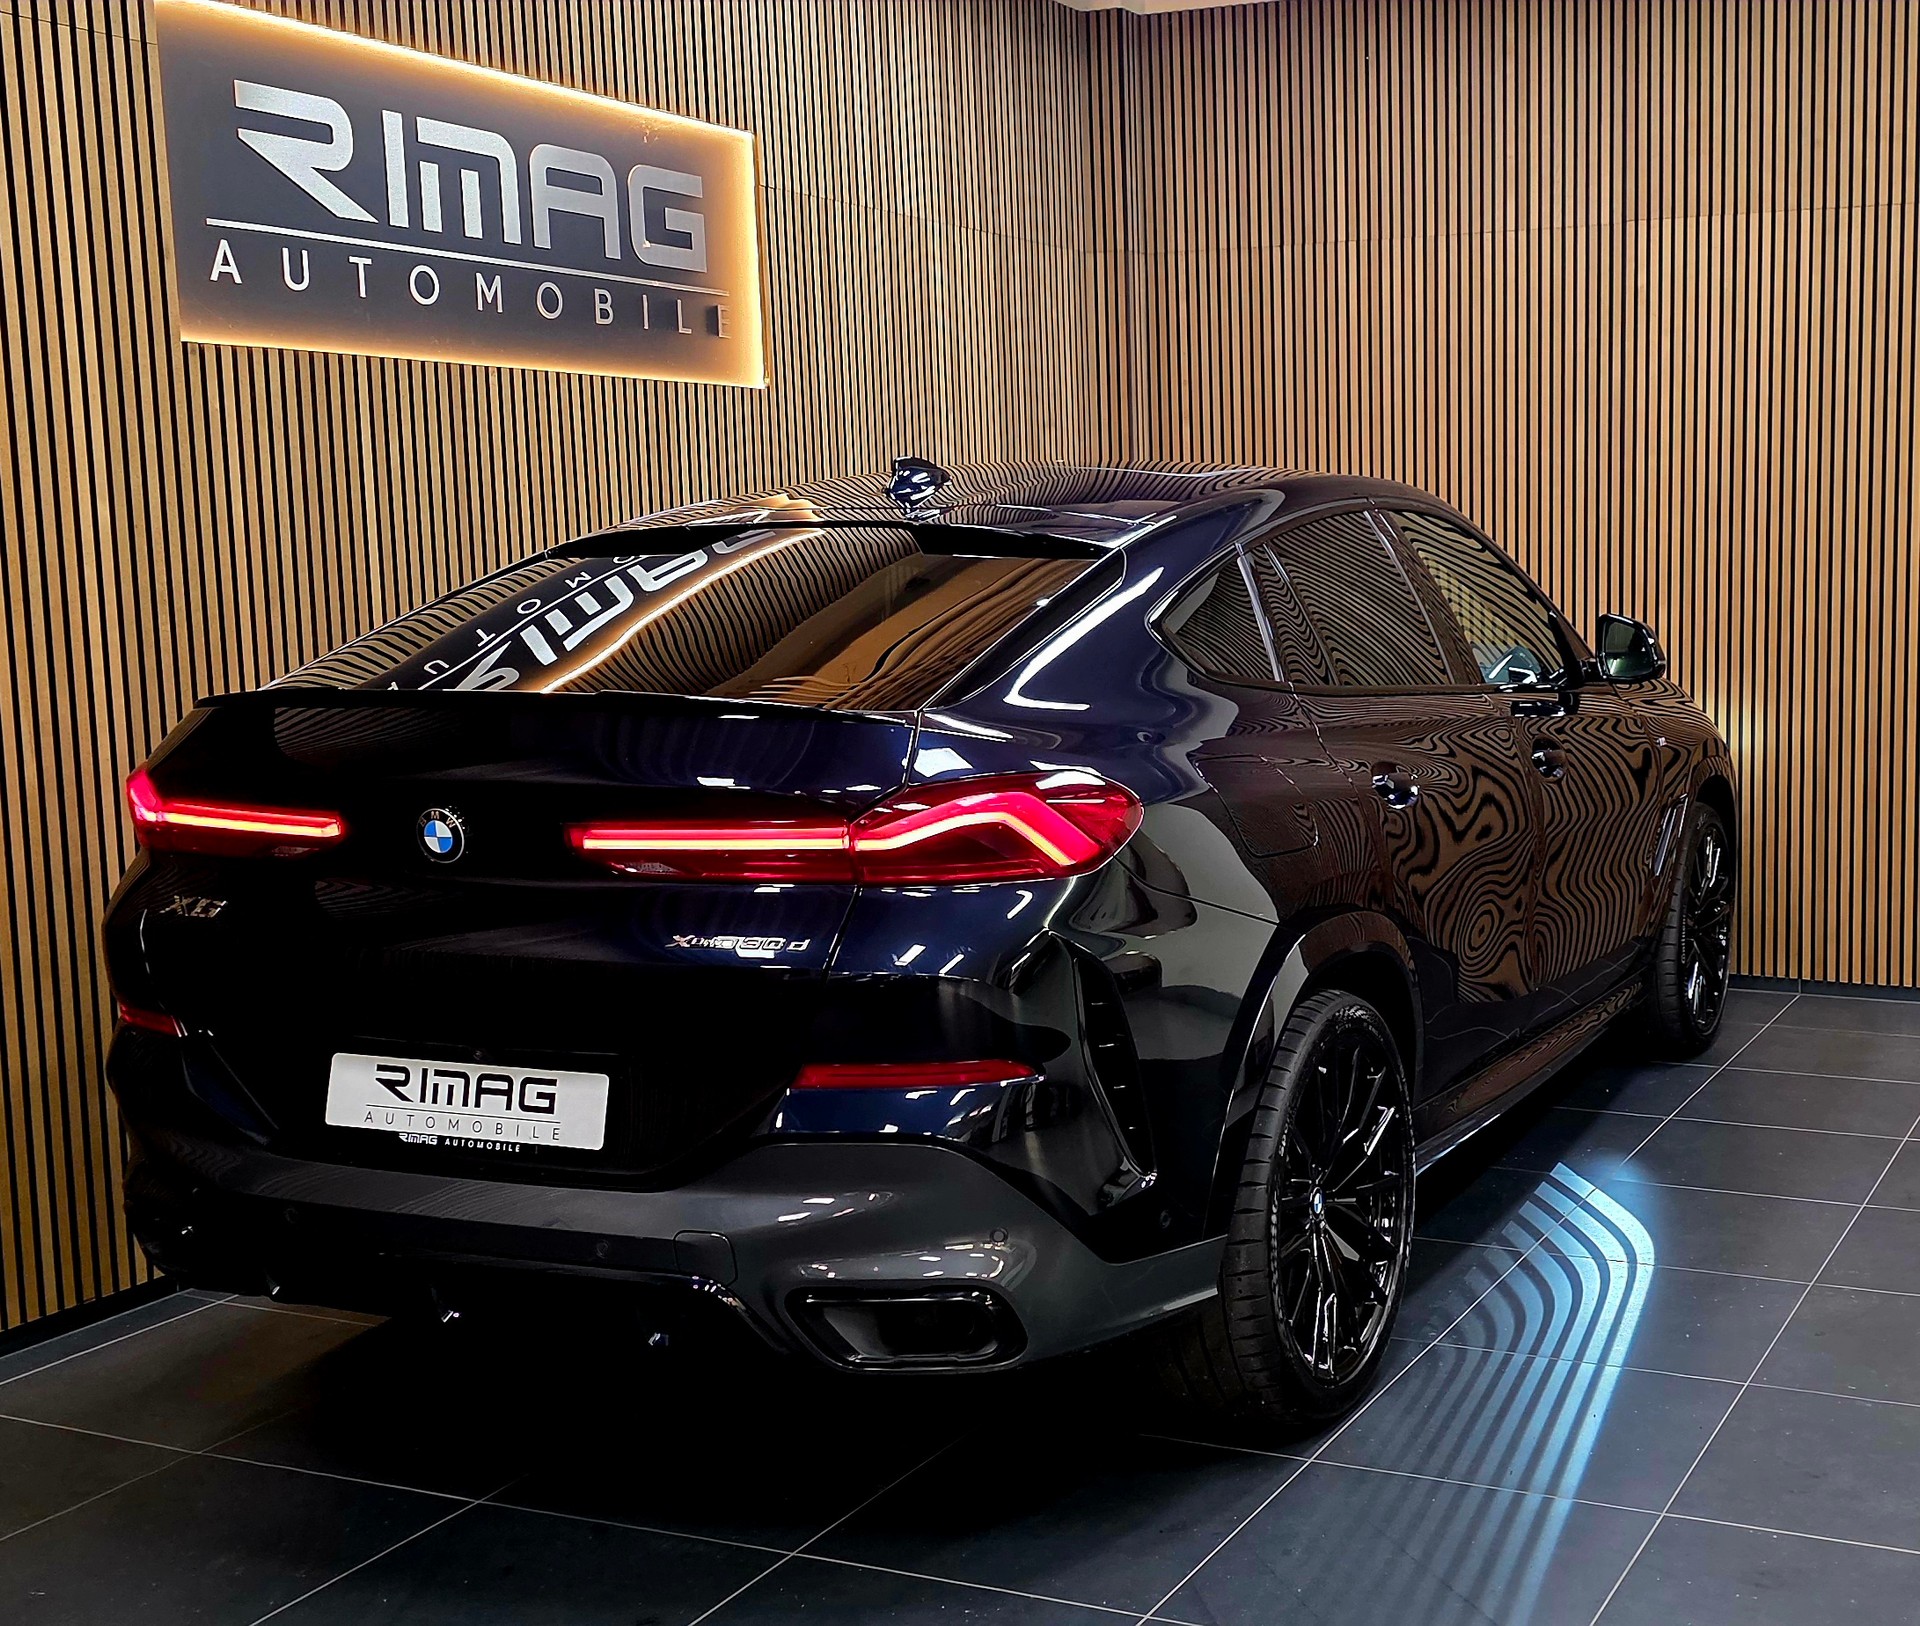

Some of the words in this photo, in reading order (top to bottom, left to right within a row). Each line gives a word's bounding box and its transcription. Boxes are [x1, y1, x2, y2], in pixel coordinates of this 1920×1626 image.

[234, 79, 708, 273] RIMAG
[209, 239, 731, 338] AUTOMOBILE
[375, 1063, 558, 1115] RIMAG
[364, 1111, 561, 1141] AUTOMOBILE
[398, 1132, 438, 1146] RIMAG
[444, 1137, 521, 1153] AUTOMOBILE
